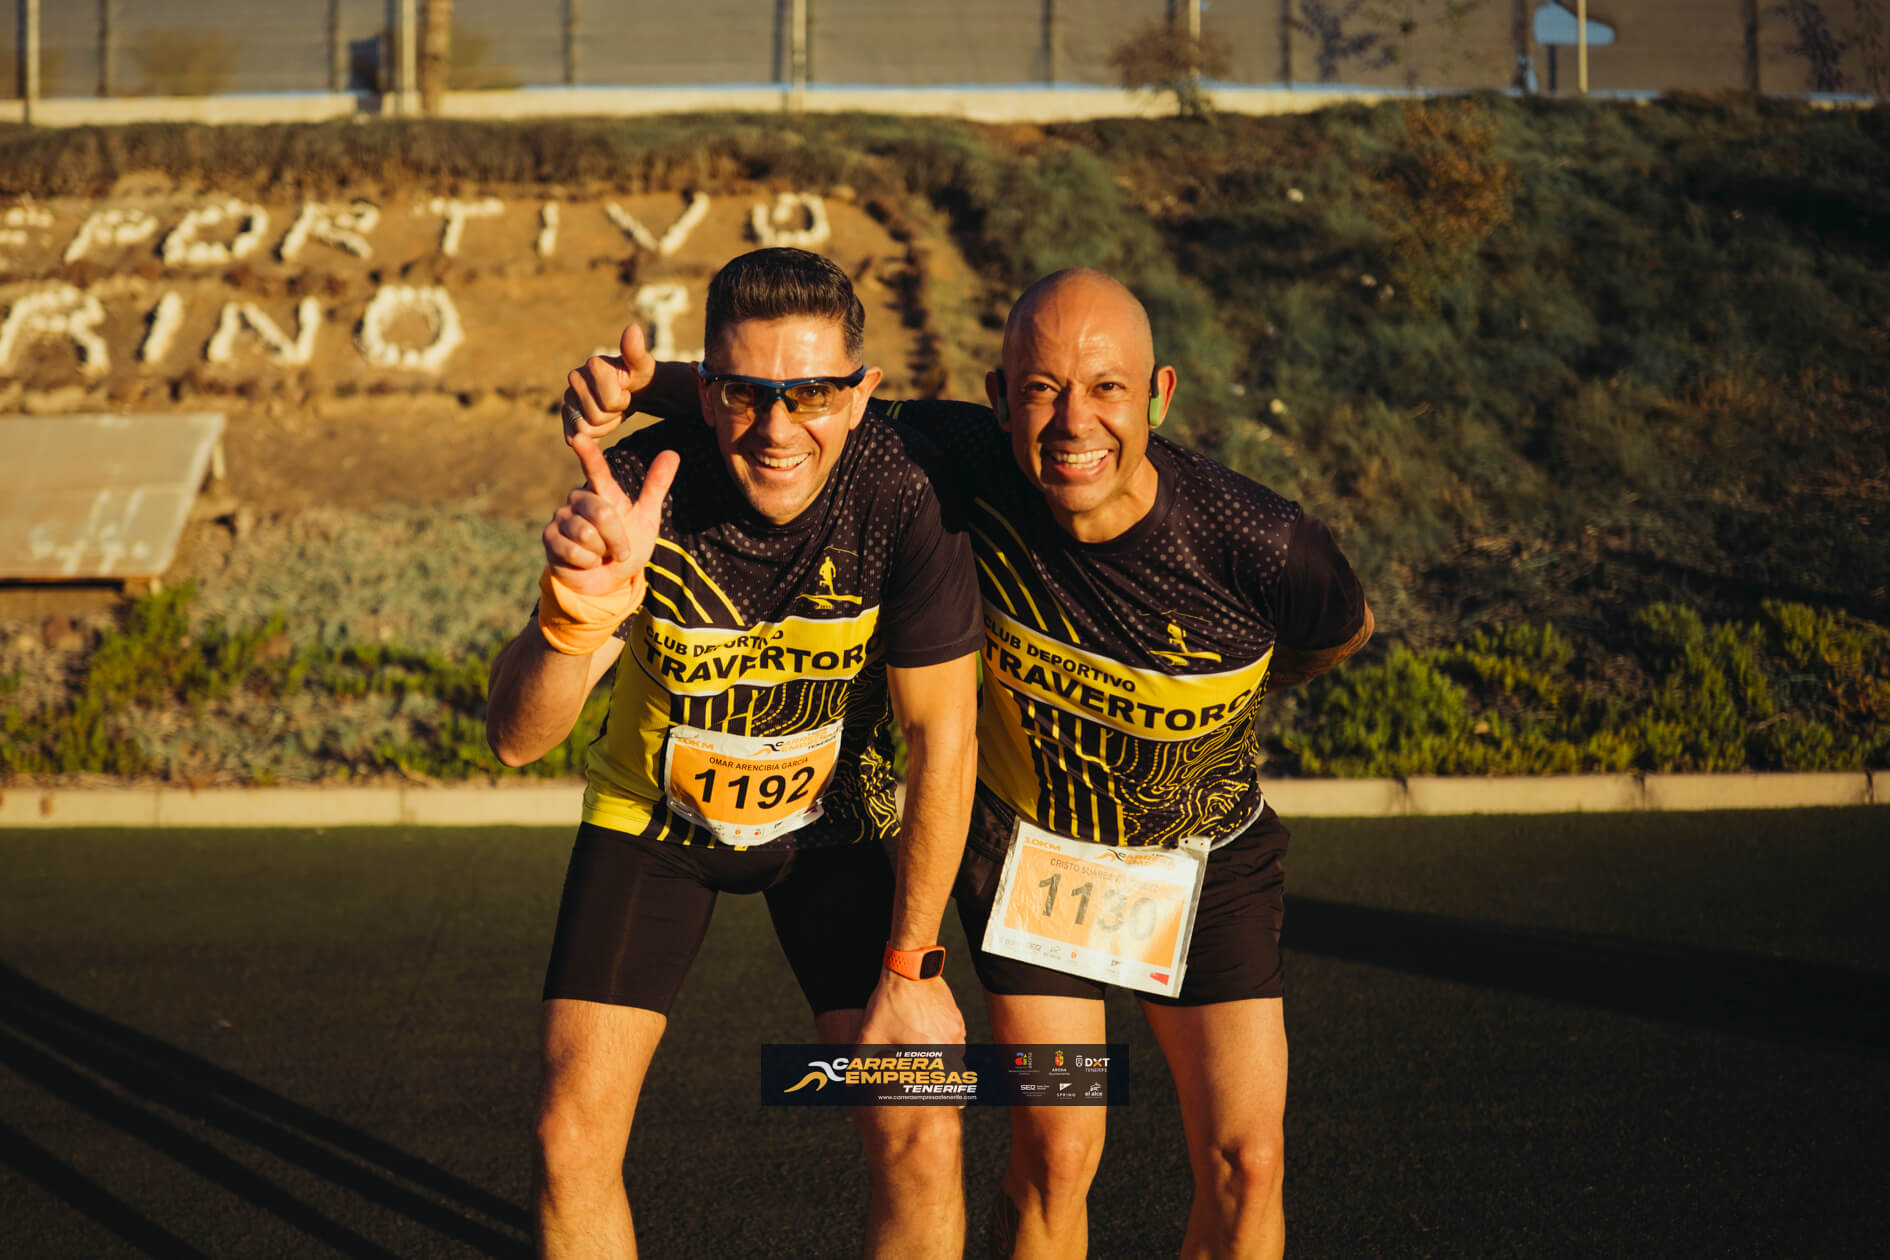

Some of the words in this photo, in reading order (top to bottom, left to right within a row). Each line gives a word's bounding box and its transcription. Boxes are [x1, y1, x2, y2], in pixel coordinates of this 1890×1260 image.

[646, 625, 688, 655] CLUB
[984, 616, 1021, 649] CLUB
[1027, 643, 1136, 692] DEPORTIVO
[709, 757, 733, 769] OMAR
[735, 763, 780, 772] ARENCIBIA
[694, 767, 815, 809] 1192
[1024, 836, 1062, 852] 10KM
[1050, 858, 1080, 872] CRISTO
[1039, 873, 1157, 940] 1130
